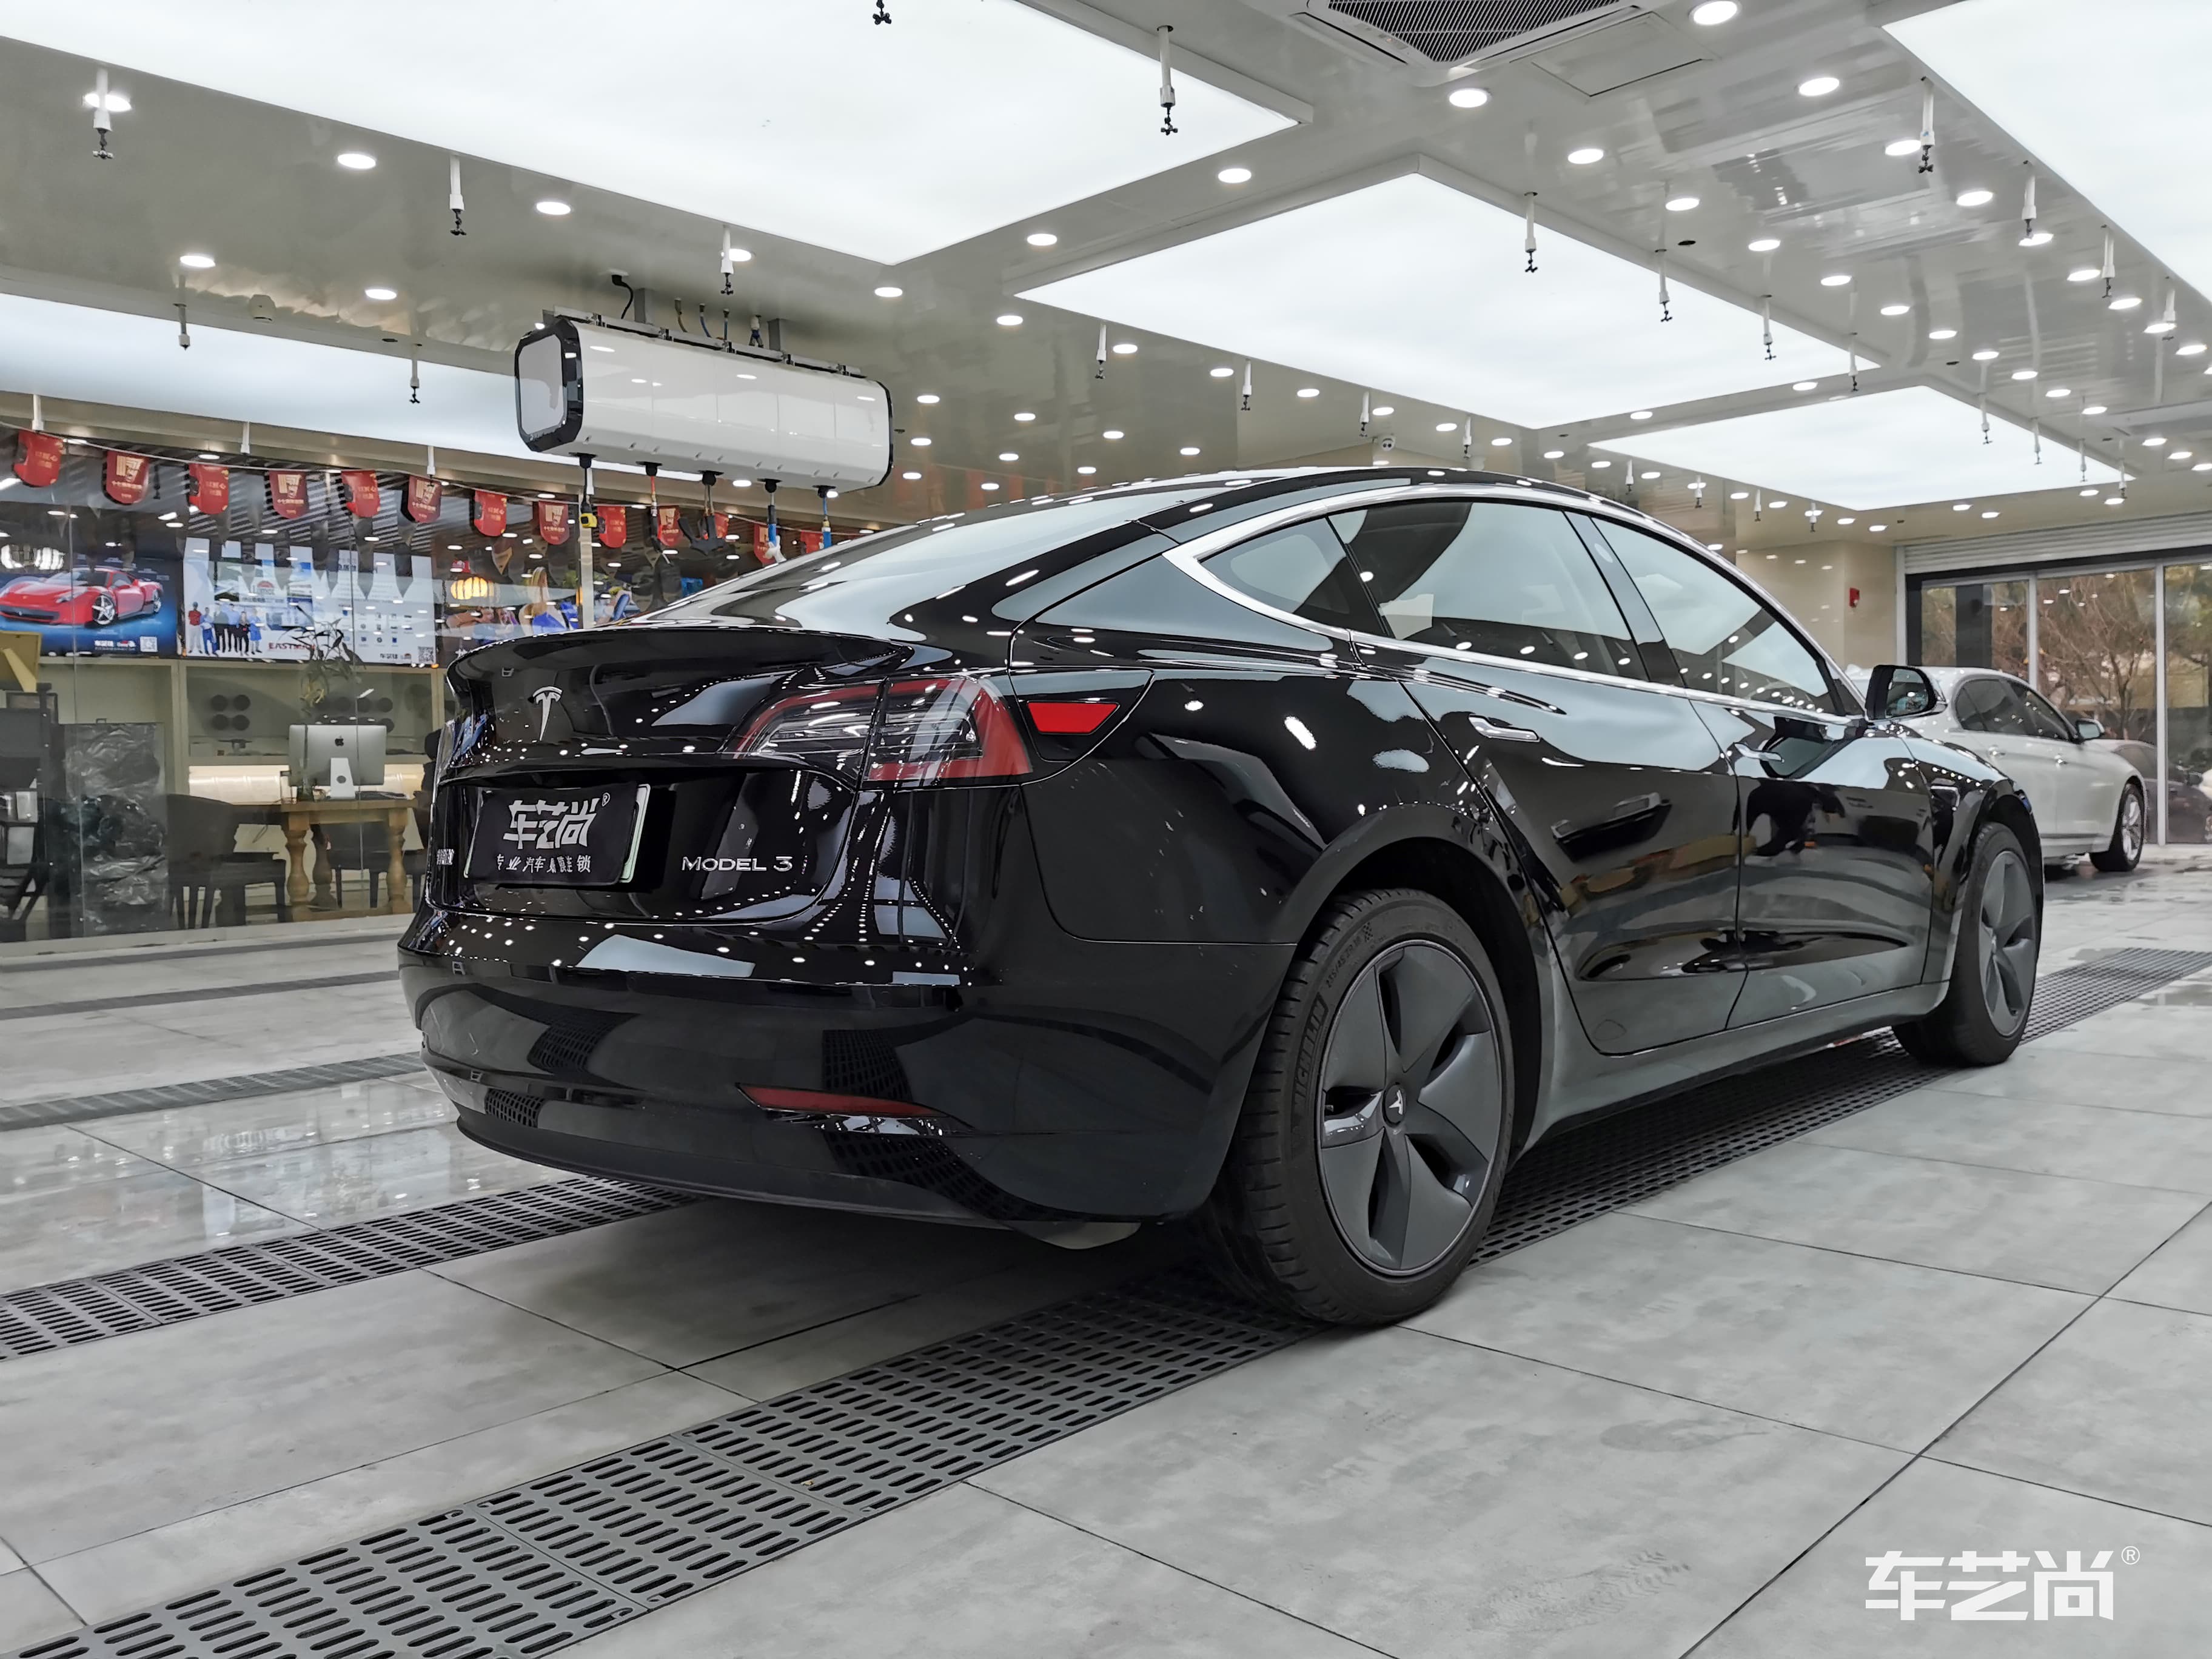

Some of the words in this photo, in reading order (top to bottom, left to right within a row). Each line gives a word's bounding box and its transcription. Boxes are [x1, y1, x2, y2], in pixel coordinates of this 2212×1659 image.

[269, 642, 316, 651] EASTM
[682, 856, 767, 871] MODEL
[773, 856, 793, 872] 3
